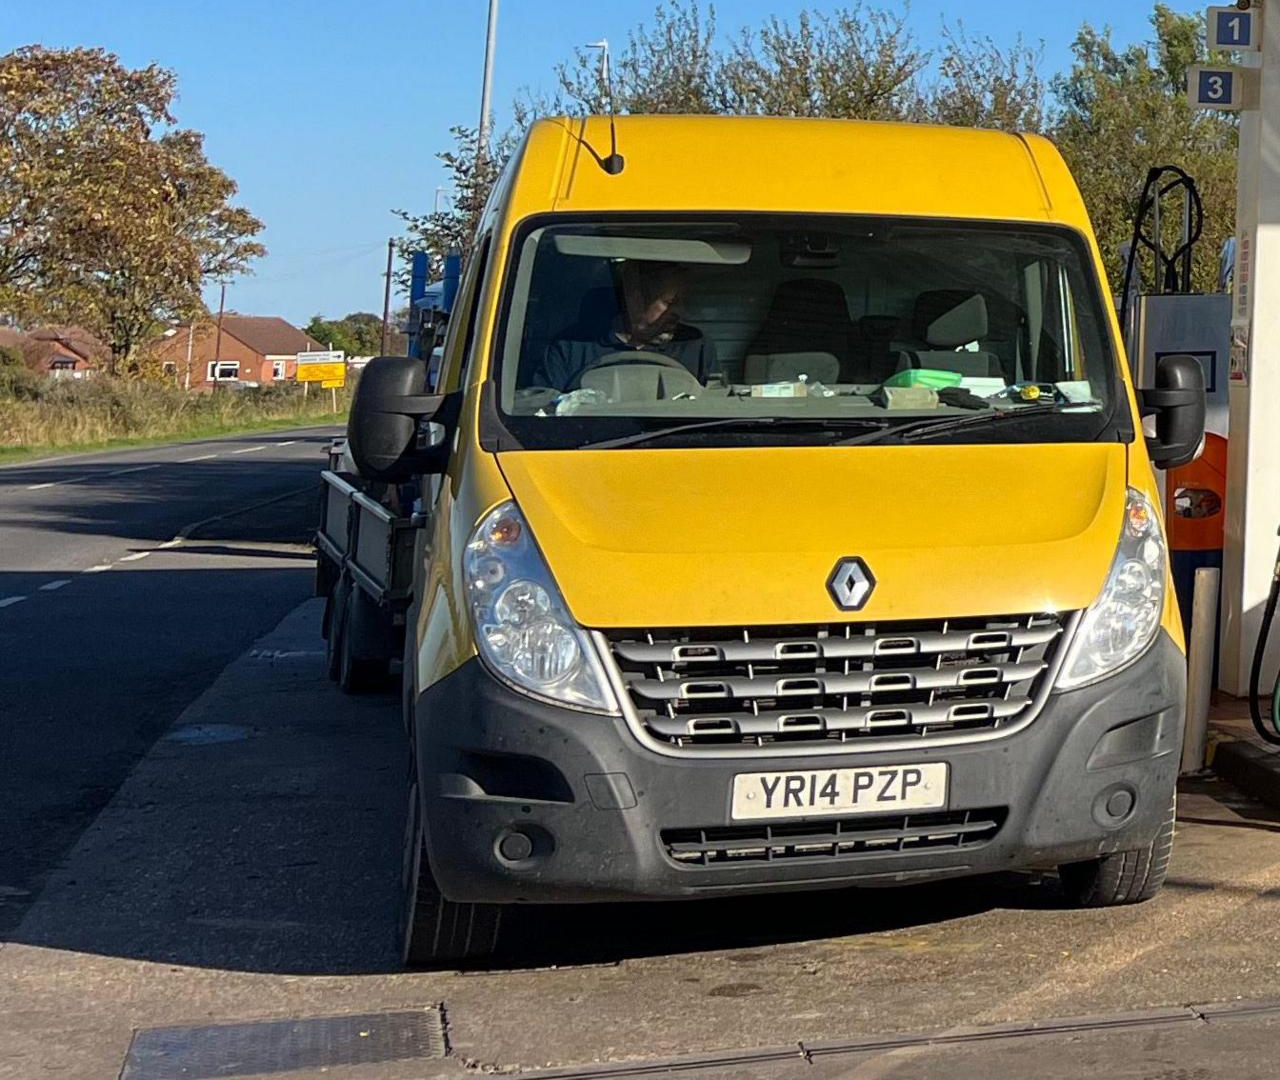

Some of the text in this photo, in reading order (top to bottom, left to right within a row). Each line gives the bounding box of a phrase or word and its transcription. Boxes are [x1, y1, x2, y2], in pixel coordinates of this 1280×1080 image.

[1228, 17, 1241, 41] 1
[1208, 76, 1224, 99] 3
[761, 768, 923, 808] YR14 PZP
